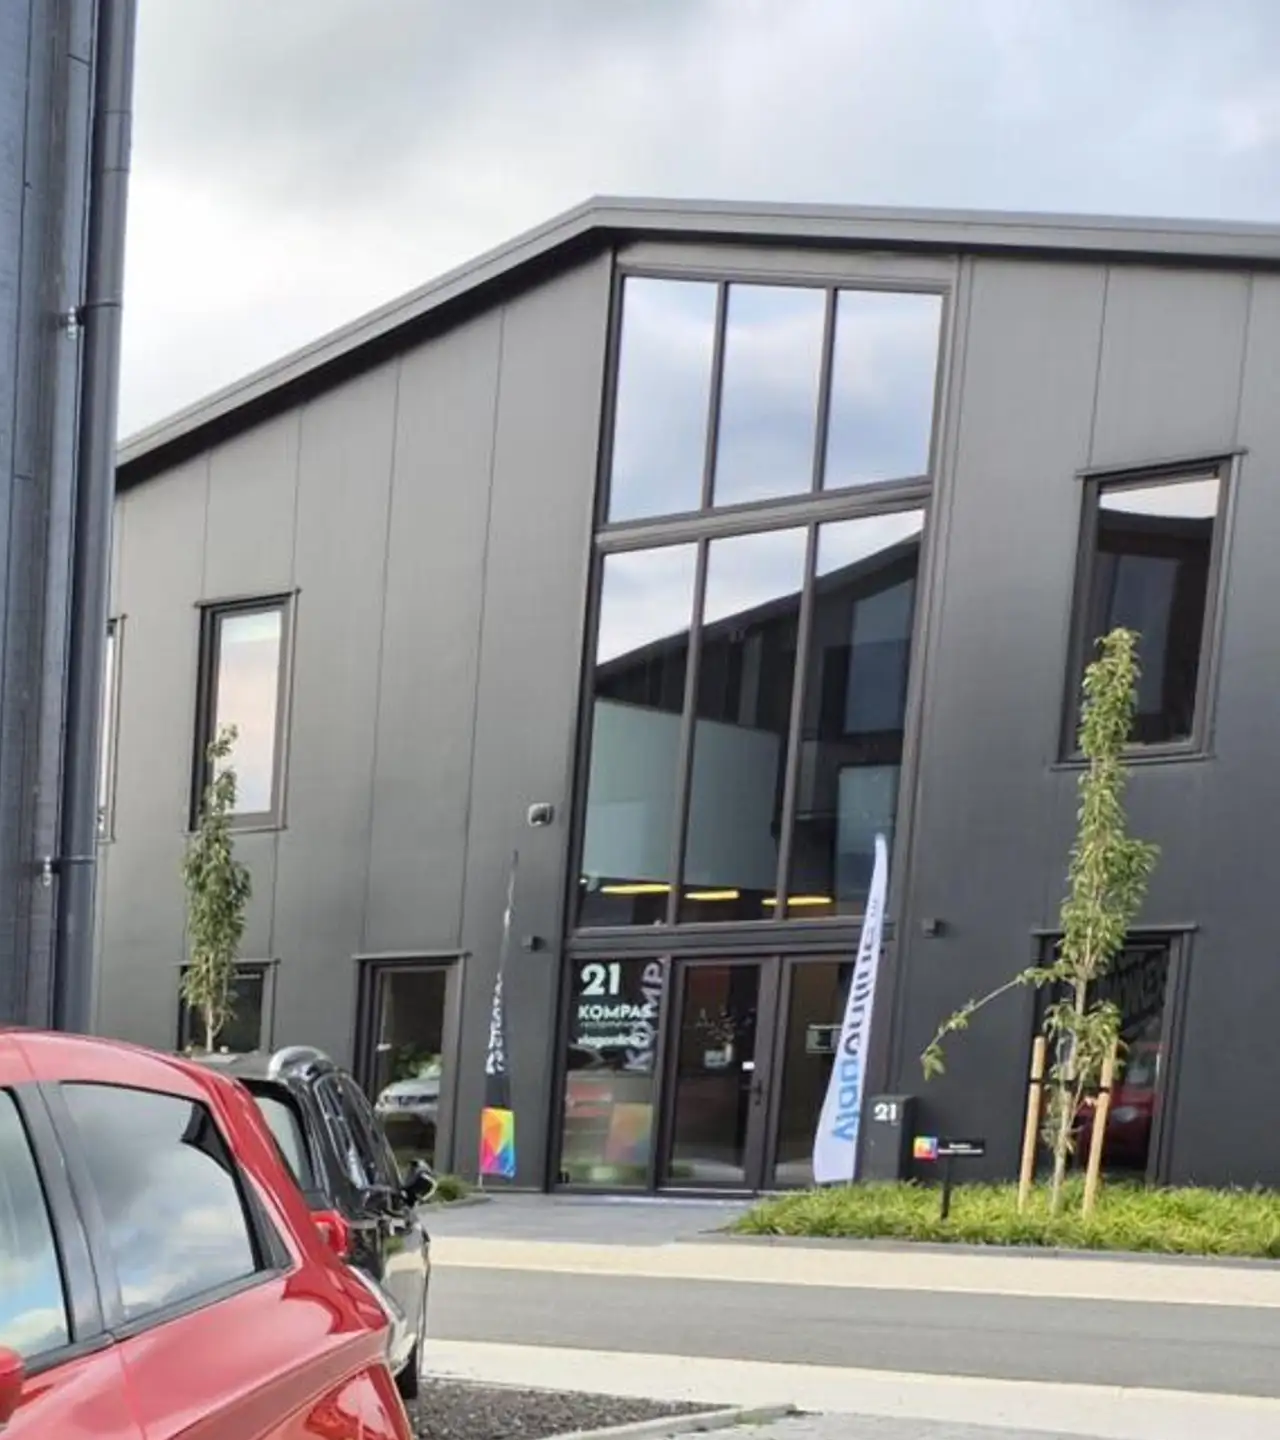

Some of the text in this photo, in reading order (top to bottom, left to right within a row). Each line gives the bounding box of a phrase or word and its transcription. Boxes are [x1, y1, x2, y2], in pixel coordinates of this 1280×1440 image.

[580, 962, 621, 996] 21
[578, 1004, 653, 1019] KOMPAS
[874, 1102, 897, 1121] 21
